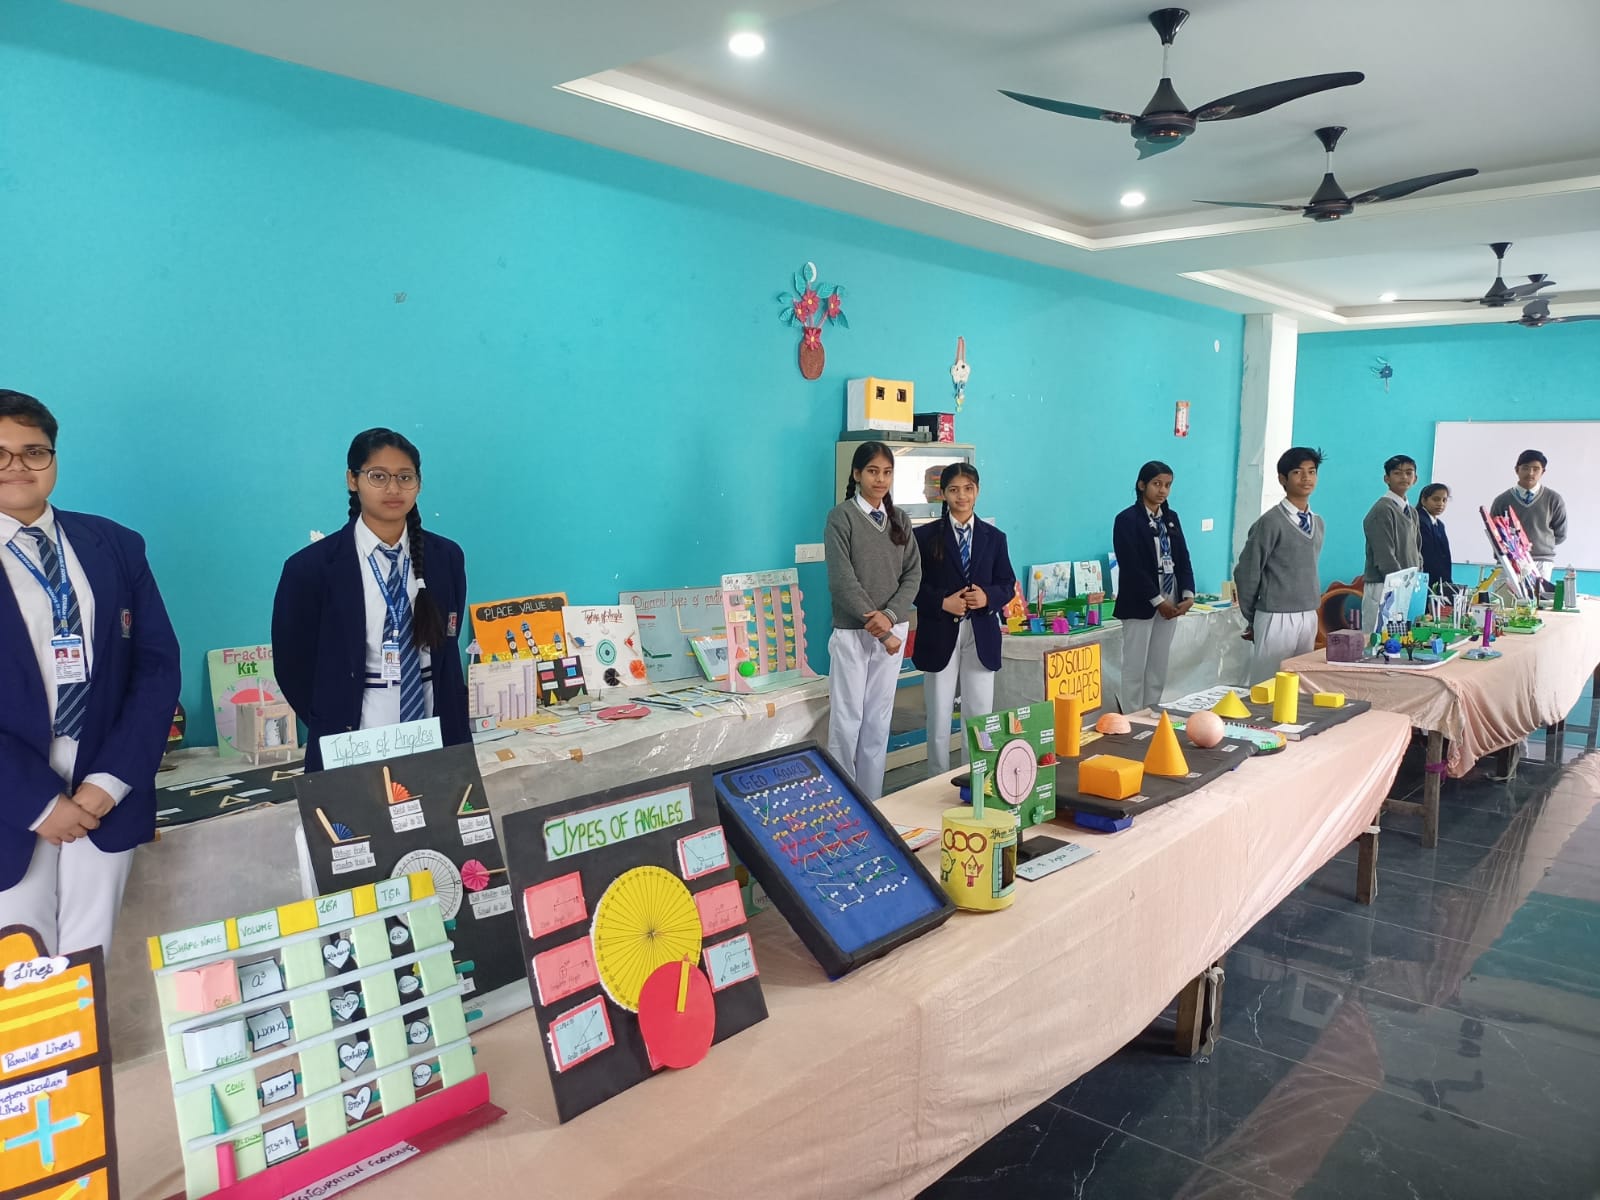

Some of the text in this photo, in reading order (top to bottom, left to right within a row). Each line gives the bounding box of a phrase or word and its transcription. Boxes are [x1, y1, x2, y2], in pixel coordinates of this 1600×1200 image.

[484, 605, 513, 619] PLACE
[519, 600, 547, 612] VALUE
[223, 646, 273, 664] Fractio
[1048, 647, 1093, 679] 3D SOLID
[238, 661, 258, 674] Kit
[546, 816, 608, 856] TYPES
[609, 811, 629, 839] OF
[241, 922, 273, 937] VOLUME
[14, 963, 54, 979] Lines
